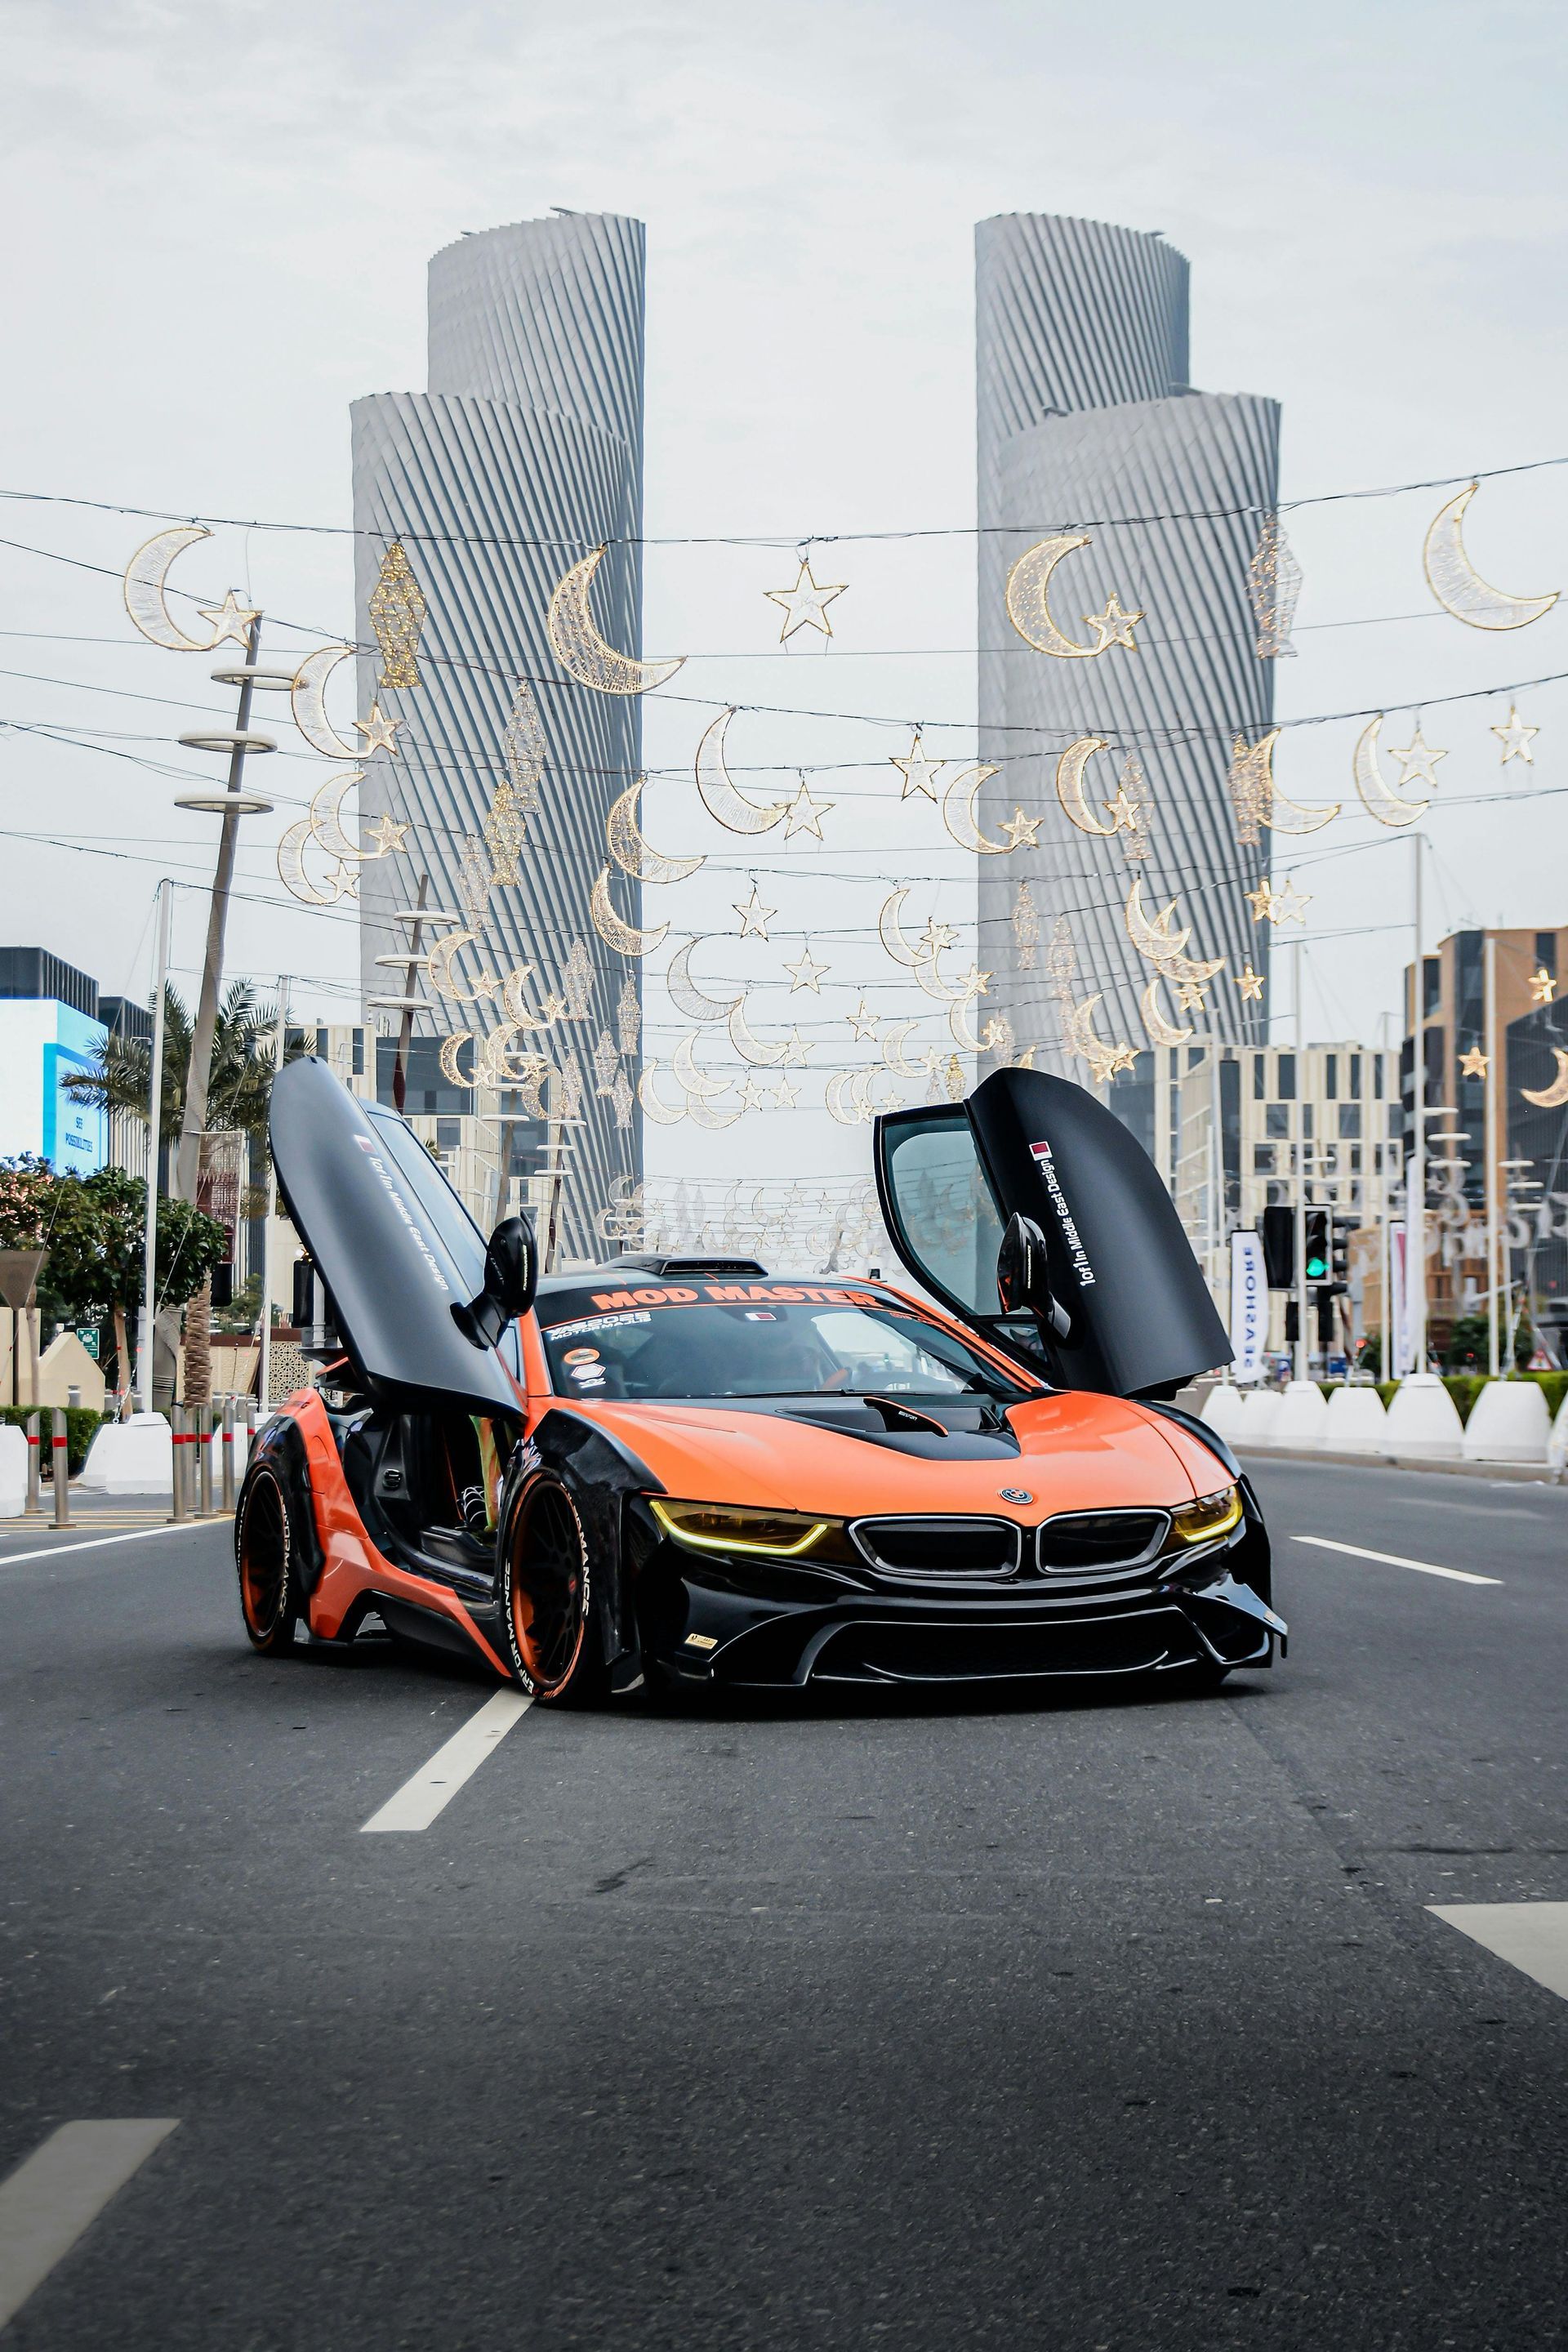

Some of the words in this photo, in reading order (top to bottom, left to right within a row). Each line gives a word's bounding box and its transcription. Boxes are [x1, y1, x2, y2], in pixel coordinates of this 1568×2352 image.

[1040, 1159, 1061, 1193] Design
[1051, 1192, 1070, 1216] East
[1062, 1217, 1083, 1250] Middle
[409, 1227, 430, 1251] East
[424, 1253, 448, 1290] Design
[590, 1287, 699, 1311] MOD
[703, 1285, 883, 1307] MASTER
